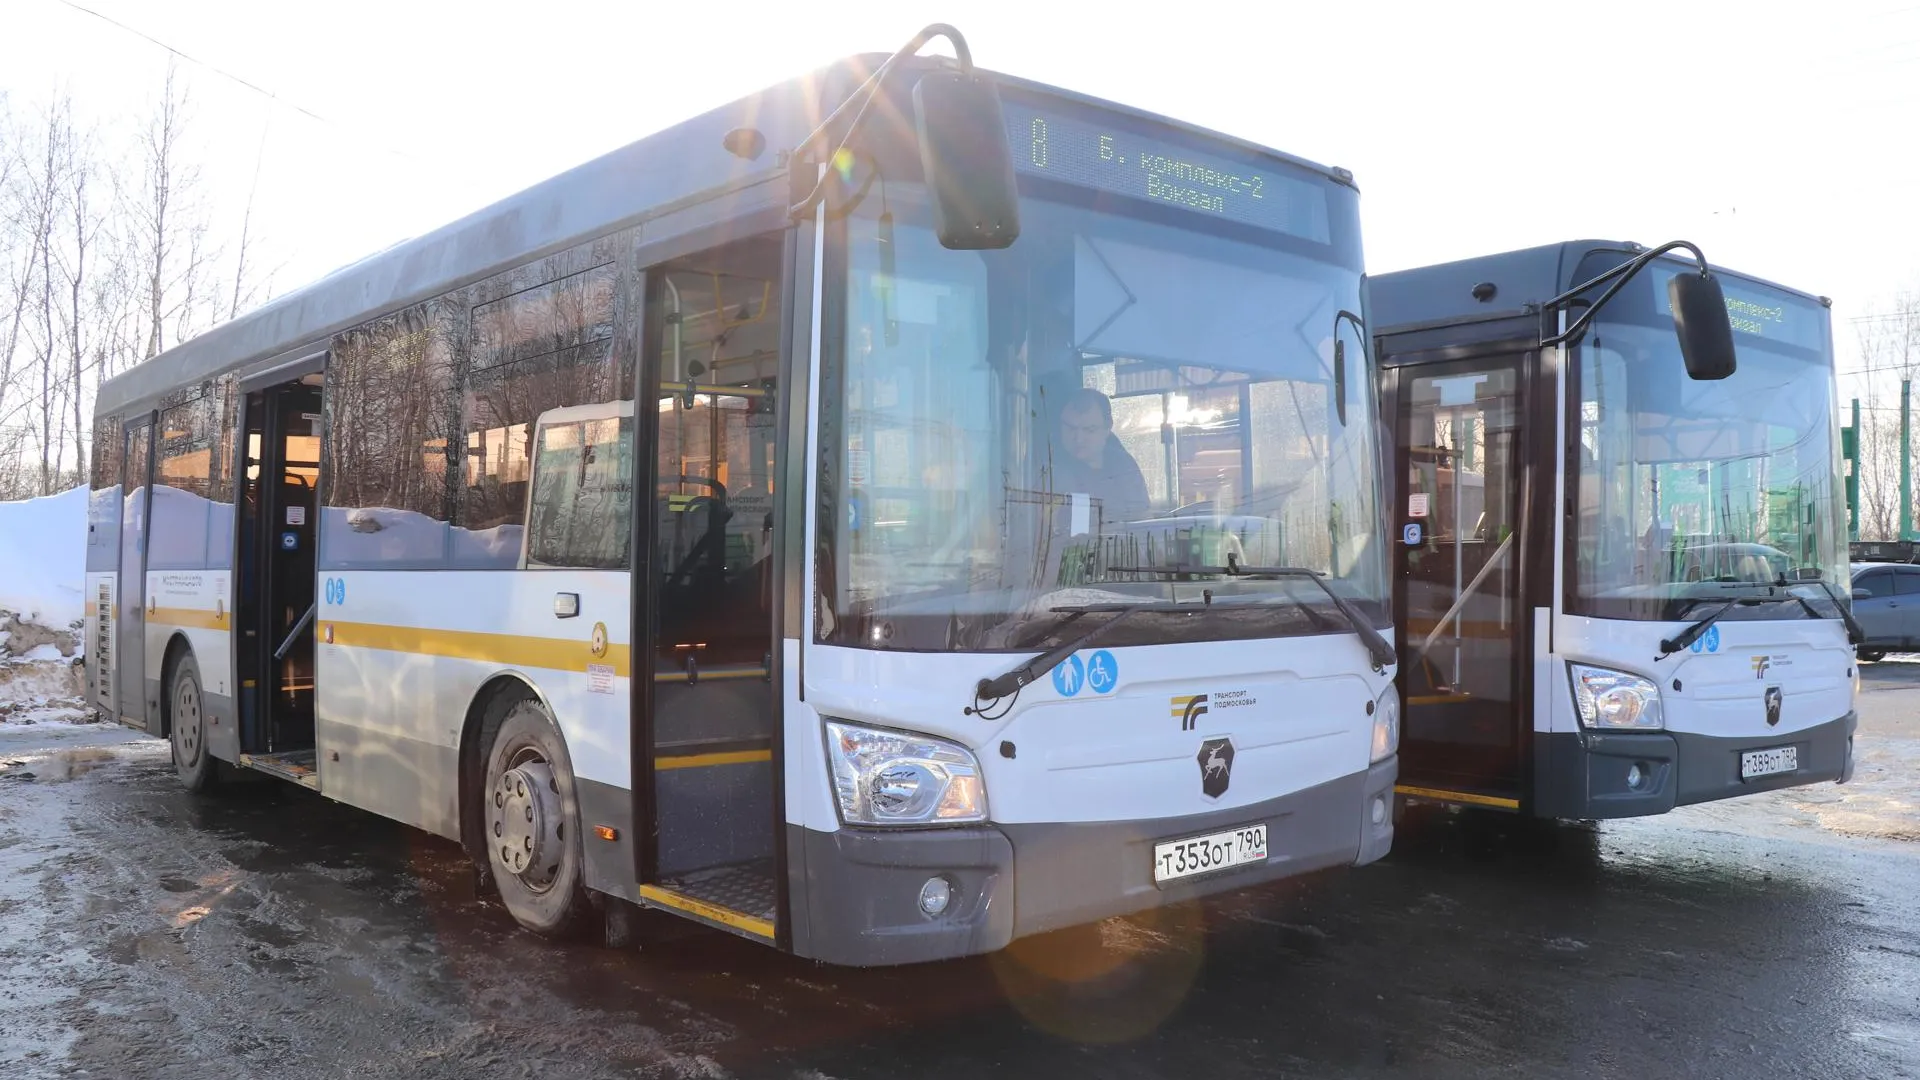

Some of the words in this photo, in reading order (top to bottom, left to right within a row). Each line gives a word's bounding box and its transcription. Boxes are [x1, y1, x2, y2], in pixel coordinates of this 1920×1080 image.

[1147, 173, 1224, 213] Вокзал
[1724, 297, 1783, 323] омплекс-2
[1214, 690, 1247, 699] ТРАНСПОРТ
[1214, 698, 1257, 709] ПОДМОСКОВЬЯ
[1162, 840, 1233, 876] Т353ОТ
[1236, 828, 1262, 853] 790
